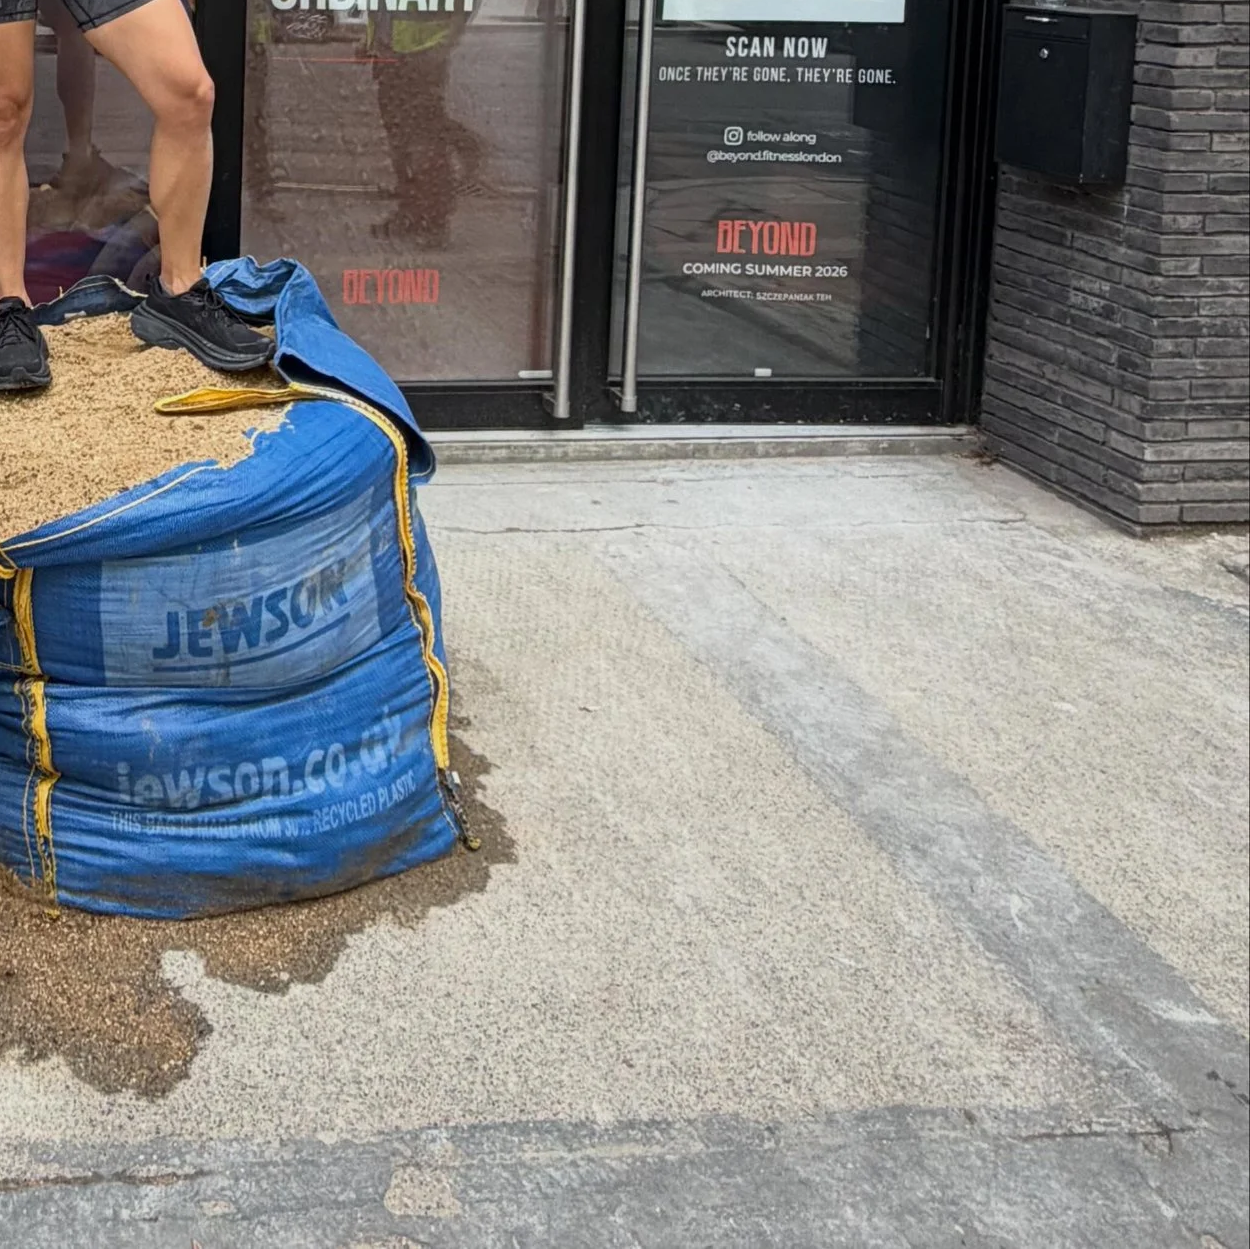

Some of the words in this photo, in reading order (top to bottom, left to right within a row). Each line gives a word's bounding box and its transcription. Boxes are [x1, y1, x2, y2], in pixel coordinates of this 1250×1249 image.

[725, 36, 775, 58] SCAN
[783, 37, 828, 58] NOW
[658, 66, 691, 82] ONCE
[696, 66, 748, 82] THEY'RE
[796, 68, 853, 83] THEY'RE
[858, 69, 897, 84] GONE.
[746, 130, 781, 142] follow
[782, 131, 817, 145] along
[716, 219, 817, 256] BEYOND
[682, 262, 742, 275] COMING
[745, 263, 812, 277] SUMMER
[815, 265, 848, 278] 2026
[342, 269, 440, 305] BEYOND
[152, 557, 348, 660] JEWSON
[313, 792, 376, 833] RECYCLED
[377, 769, 416, 811] PLASTIC
